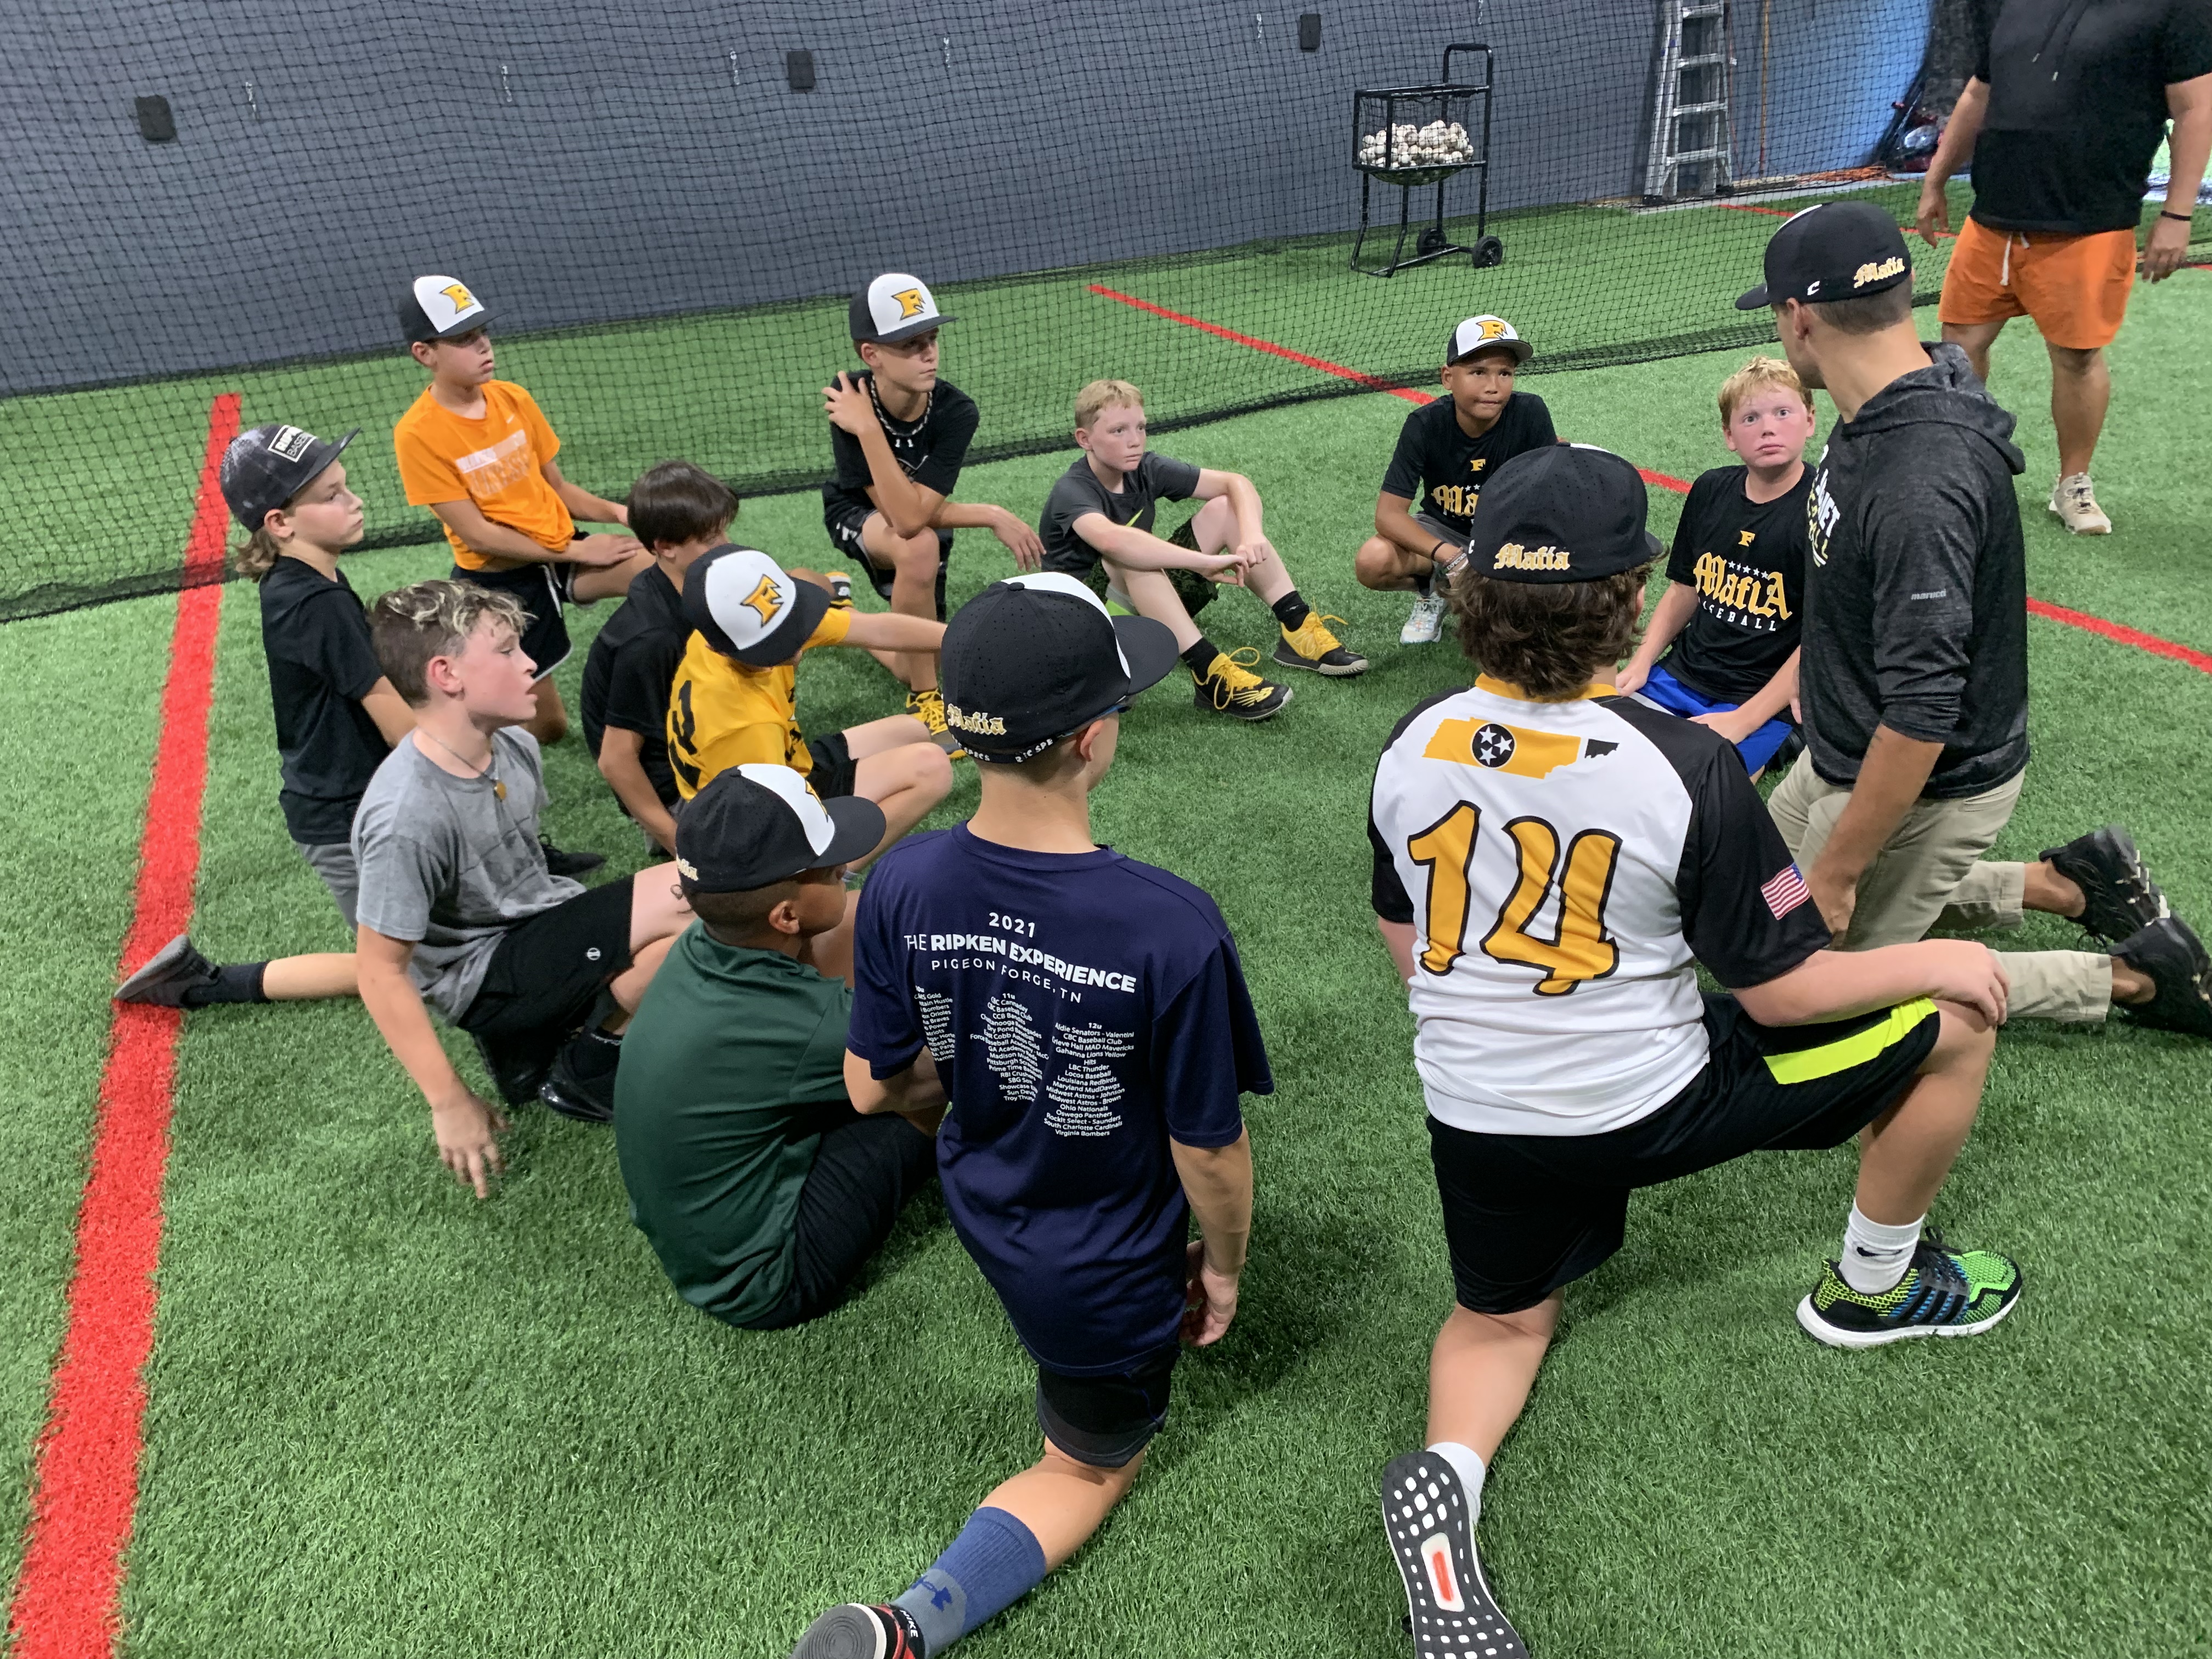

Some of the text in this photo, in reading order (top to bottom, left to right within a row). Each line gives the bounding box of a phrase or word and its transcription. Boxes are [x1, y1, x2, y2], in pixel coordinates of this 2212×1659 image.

[1738, 530, 1756, 547] F
[1407, 799, 1623, 997] 14
[989, 912, 1035, 938] 2021
[904, 934, 1137, 993] THE RIPKEN EXPERIENCE
[932, 958, 1082, 1003] PIGEON FORGE, TN
[929, 1016, 950, 1024] Braves
[996, 1007, 1020, 1016] Baseball
[1020, 1012, 1032, 1022] Club
[987, 1024, 996, 1034] Dry
[1071, 1027, 1101, 1036] Senators
[1063, 1033, 1077, 1042] CBC
[998, 1045, 1025, 1054] Academy
[1070, 1042, 1084, 1051] Hall
[1056, 1047, 1086, 1059] Gahanna
[986, 1058, 1019, 1066] Pittsburgh
[1068, 1063, 1110, 1073] LBC Thunder
[1065, 1070, 1111, 1079] Locos Baseball
[1057, 1075, 1117, 1086] Louisiana Redbirds
[1046, 1085, 1073, 1097] Midwest
[1099, 1088, 1125, 1098] Johnson
[1053, 1081, 1120, 1093] Maryland MudDawgs
[1048, 1093, 1076, 1104] Midwest
[1102, 1095, 1121, 1105] Brown
[1056, 1109, 1084, 1119] Oswego
[1043, 1118, 1062, 1129] South
[1094, 1121, 1123, 1130] Cardinals
[1092, 1115, 1121, 1125] Saunders
[1055, 1128, 1080, 1137] Virginia
[899, 1610, 919, 1638] NIKE
